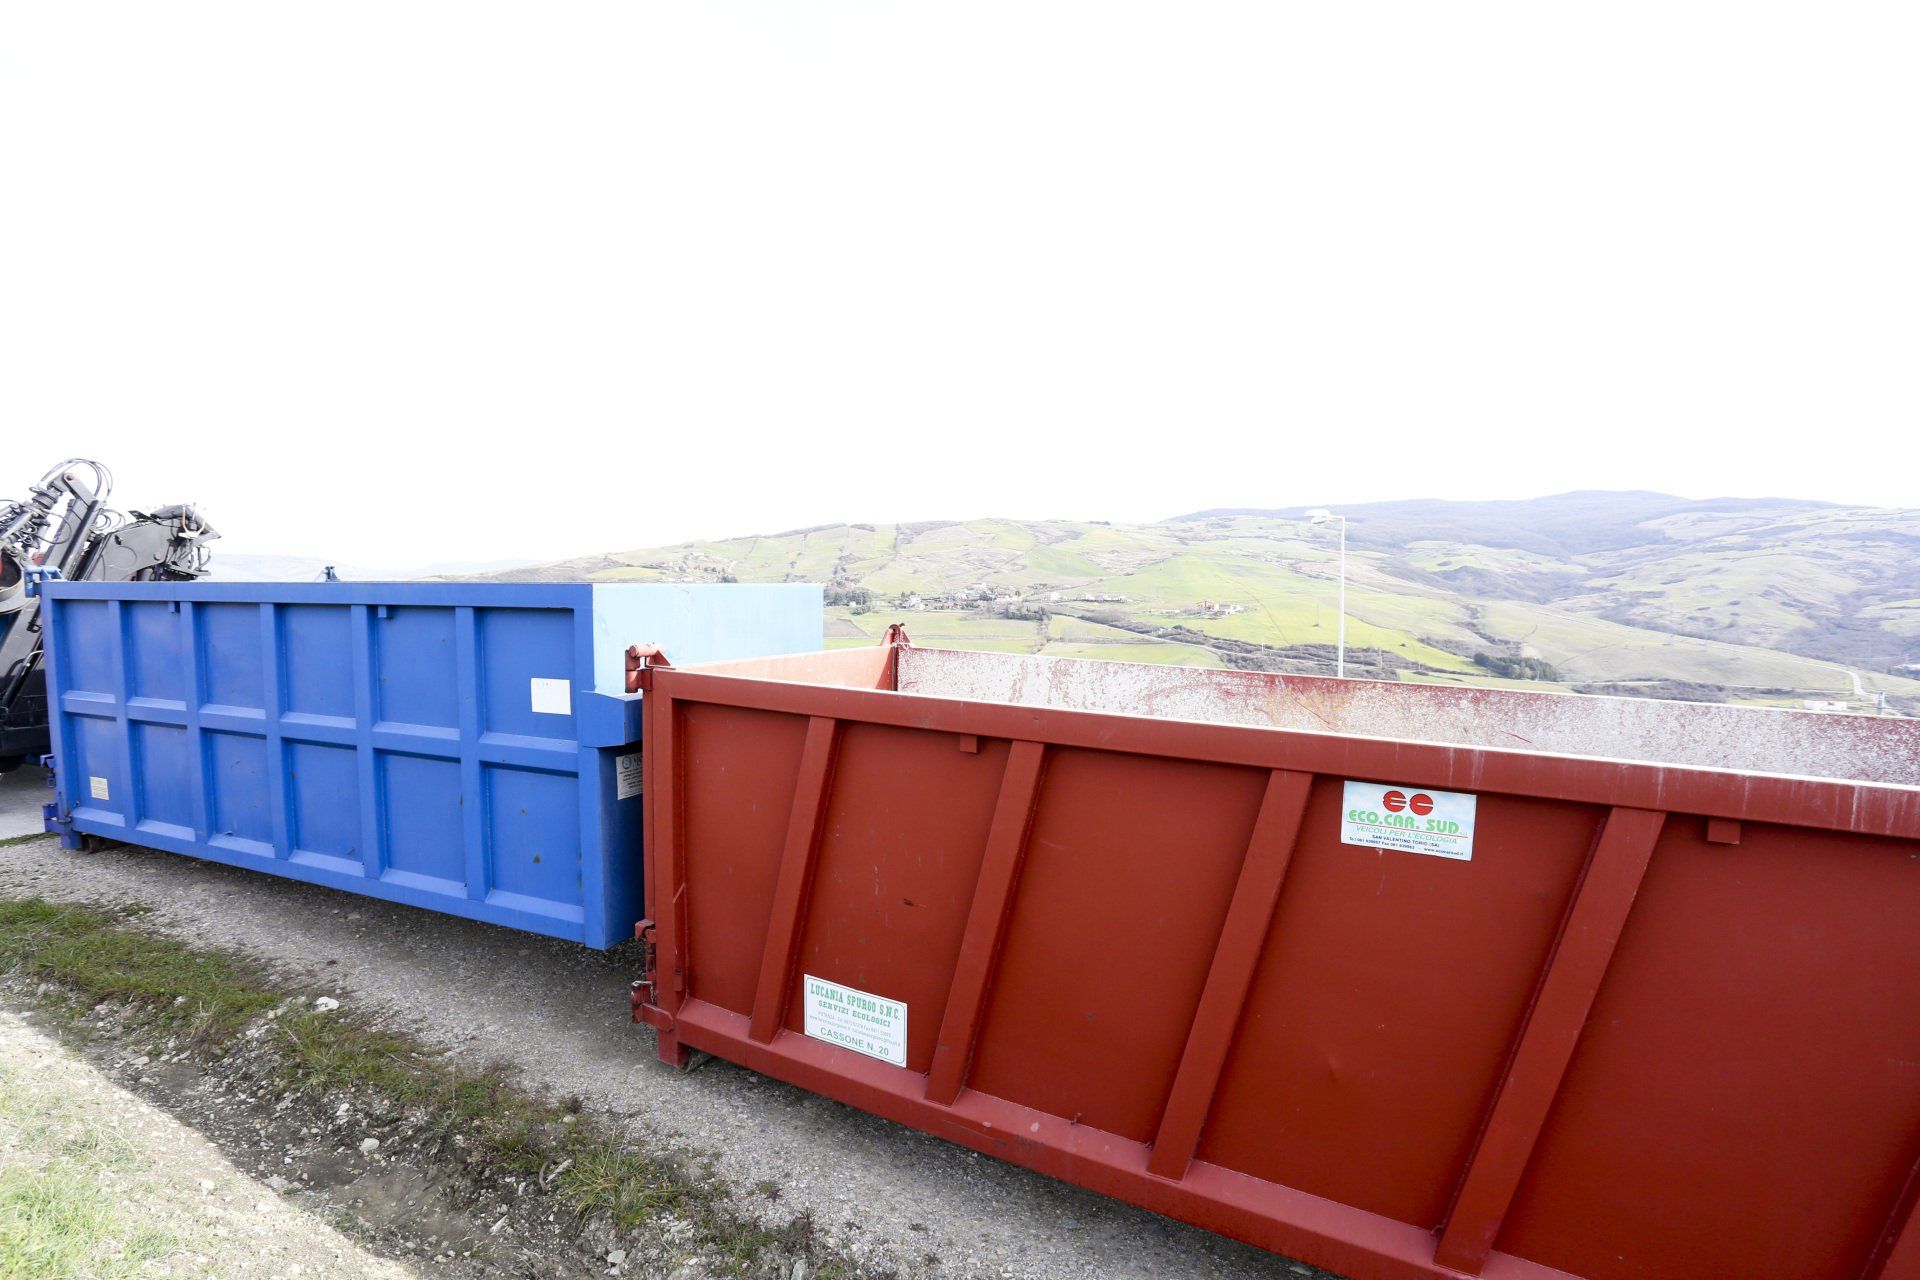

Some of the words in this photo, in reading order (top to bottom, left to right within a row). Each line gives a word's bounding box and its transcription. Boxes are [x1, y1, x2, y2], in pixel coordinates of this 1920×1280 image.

[1356, 825, 1387, 835] VEICOLI
[1390, 830, 1405, 838] PER
[1408, 832, 1458, 844] L'ECOLOGIA
[1426, 818, 1459, 834] SUD
[811, 983, 844, 1002] LUCANIA
[847, 995, 876, 1013] SPURGO
[880, 1005, 900, 1020] S.N.C.
[818, 1000, 848, 1014] SERVIZI
[852, 1011, 890, 1027] ECOLOGICI
[820, 1027, 864, 1048] CASSONE
[879, 1046, 889, 1056] 20
